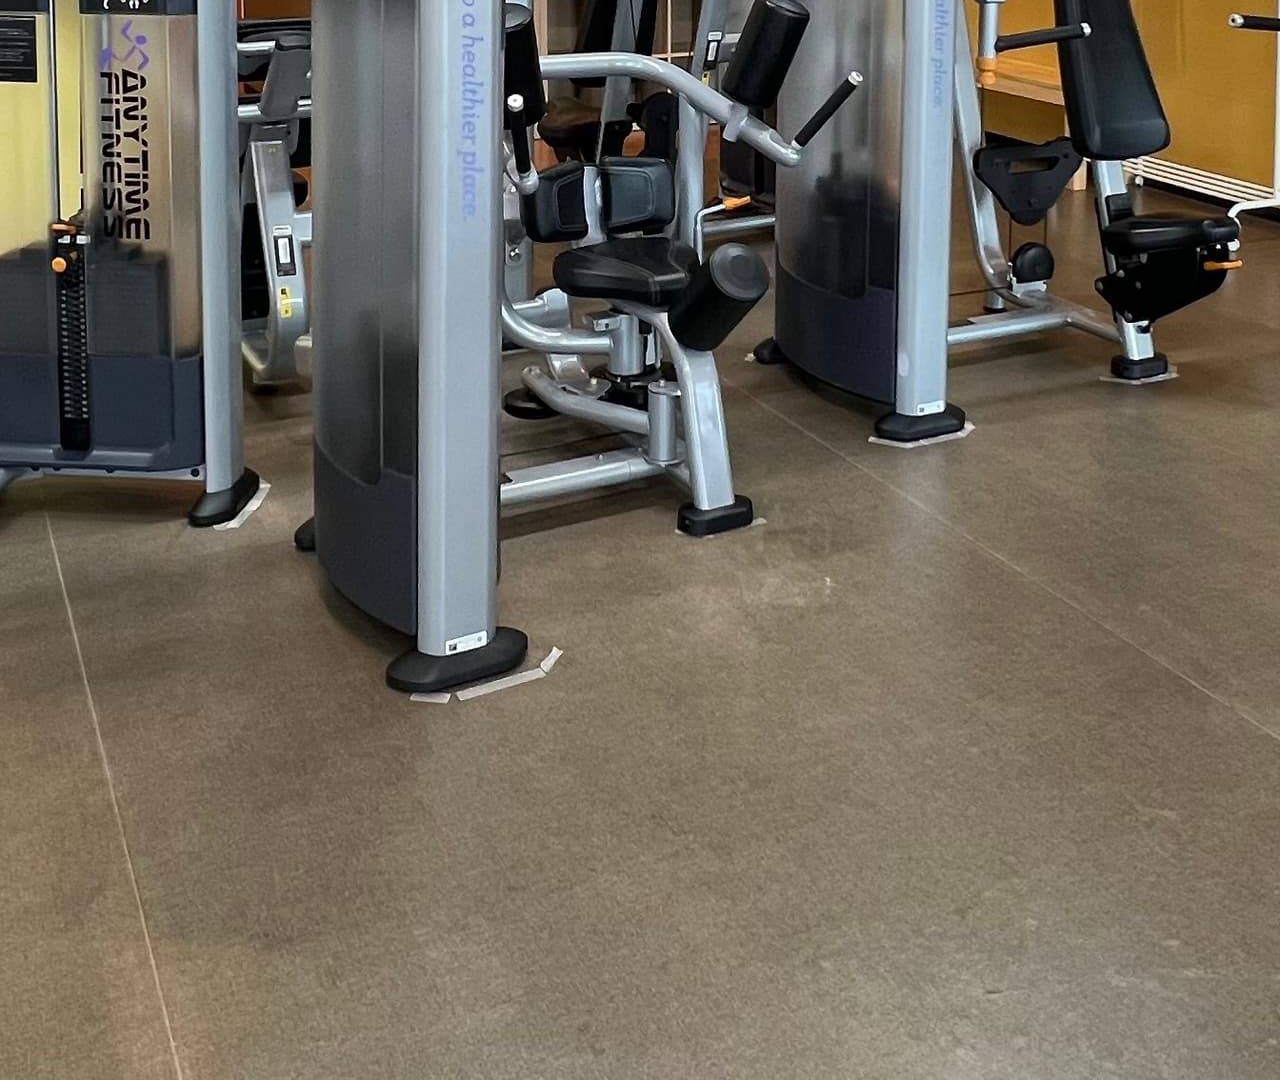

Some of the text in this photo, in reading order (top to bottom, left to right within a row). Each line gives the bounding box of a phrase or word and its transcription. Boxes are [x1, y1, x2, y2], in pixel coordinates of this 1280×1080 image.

[461, 13, 477, 28] a
[461, 34, 485, 146] healthier
[100, 71, 123, 239] FITNESS
[121, 68, 150, 241] ANYTIME
